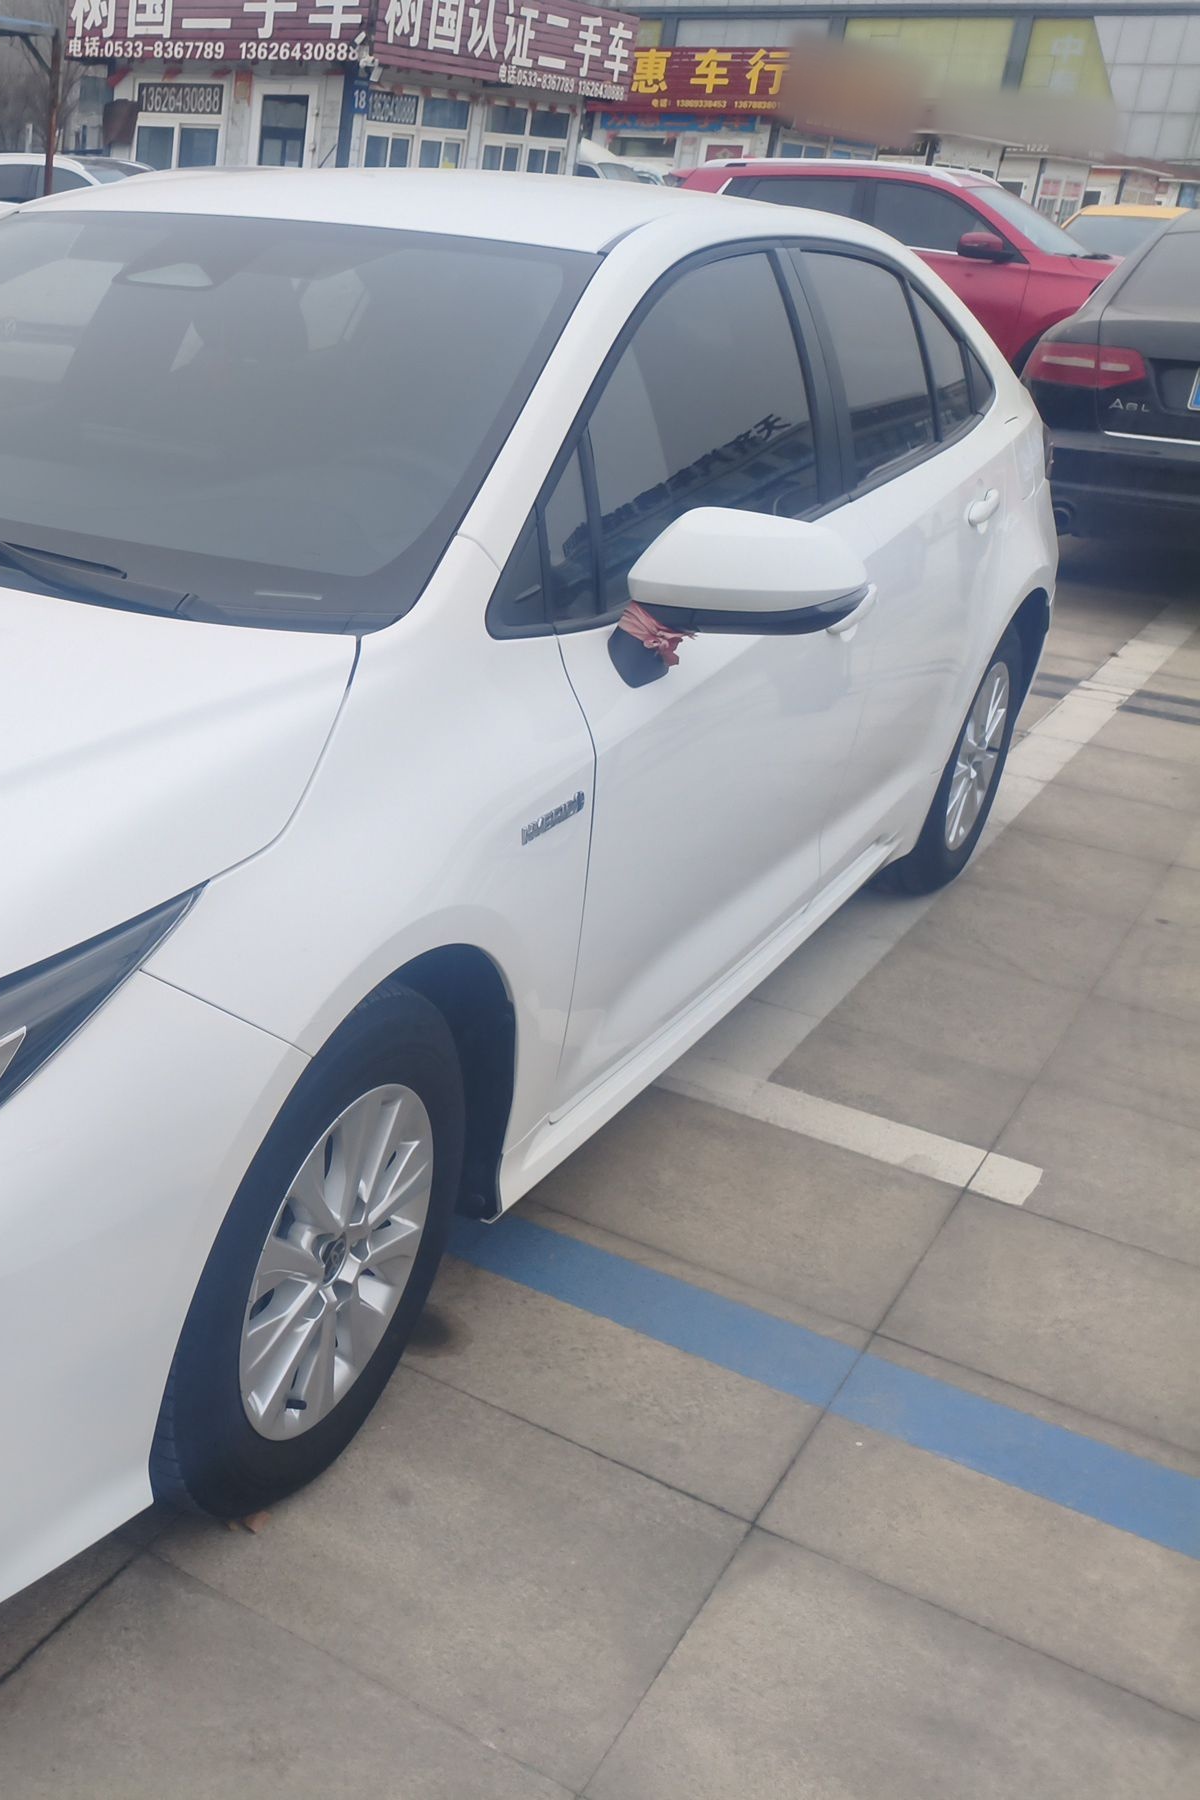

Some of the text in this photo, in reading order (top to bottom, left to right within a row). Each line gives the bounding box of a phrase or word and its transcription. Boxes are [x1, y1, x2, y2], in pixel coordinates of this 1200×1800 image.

[385, 0, 632, 82] 树国认证二手车
[239, 42, 358, 61] 13626430888
[141, 86, 220, 112] 13626430888
[354, 89, 366, 109] 18
[1108, 398, 1150, 413] A6L
